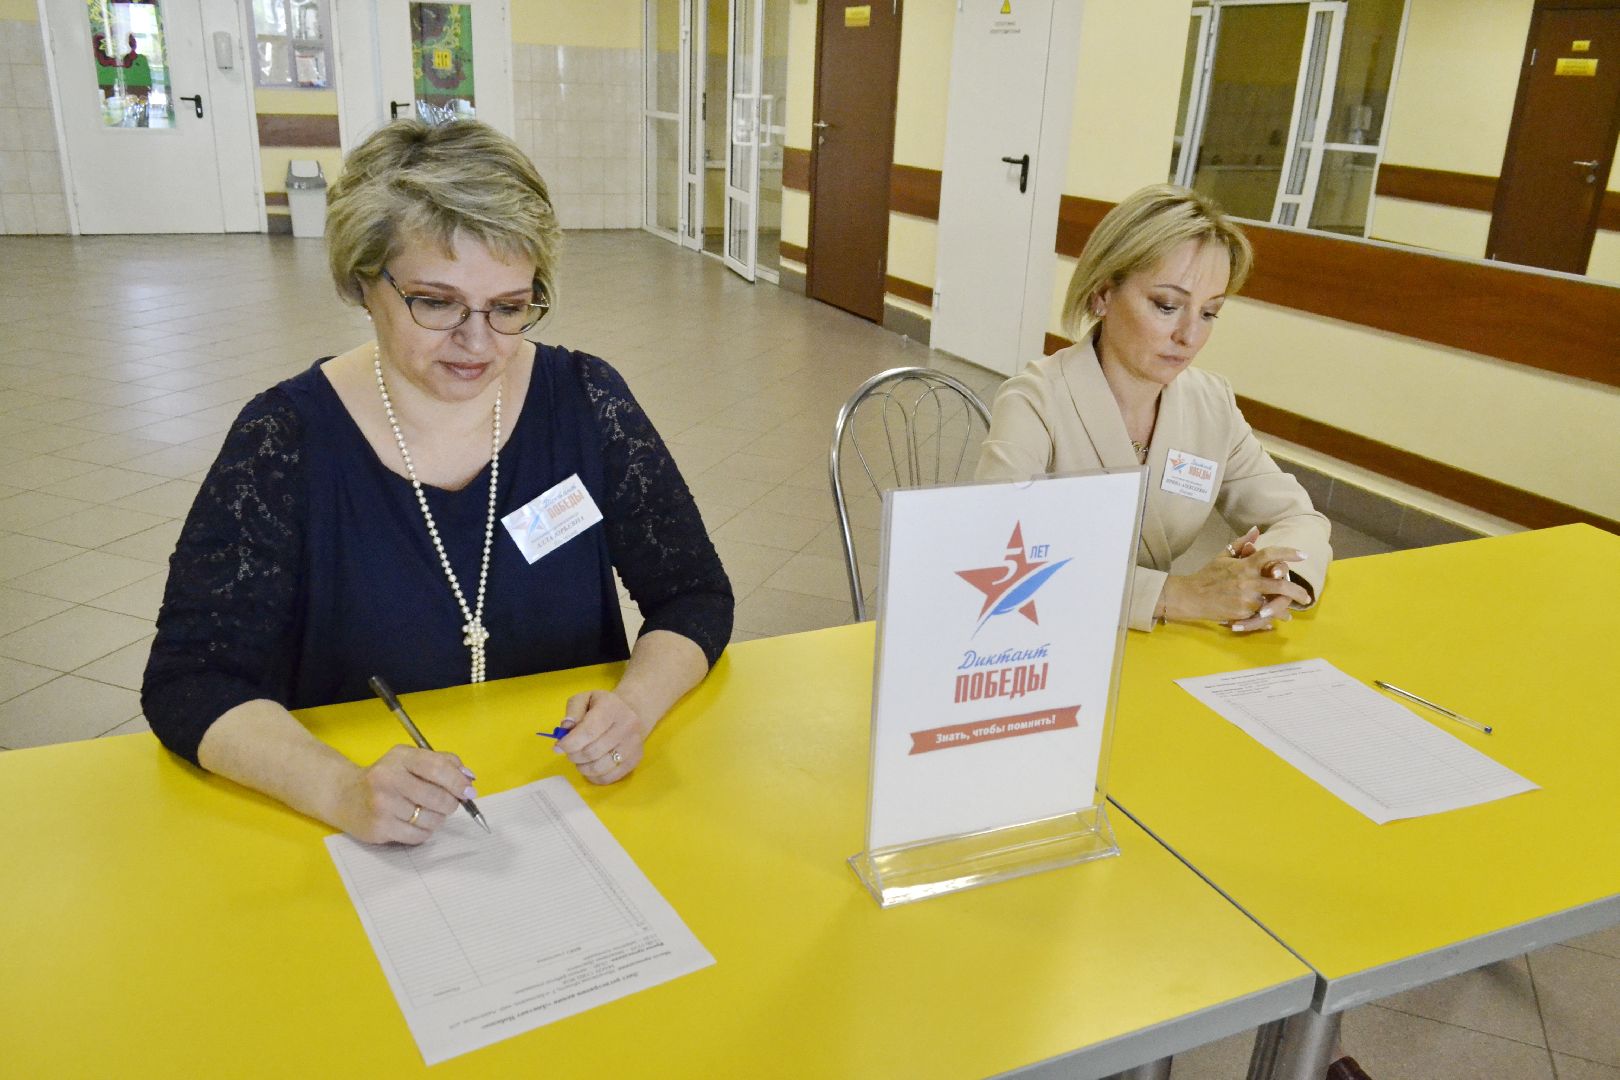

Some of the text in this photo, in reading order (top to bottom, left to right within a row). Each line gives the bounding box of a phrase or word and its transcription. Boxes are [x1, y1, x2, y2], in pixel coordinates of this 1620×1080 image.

[992, 544, 1050, 586] 5 ЛЕТ
[957, 643, 1051, 670] Диктант
[954, 662, 1049, 704] ПОБЕДЫ
[935, 714, 1056, 744] Знать, чтобы помнить!
